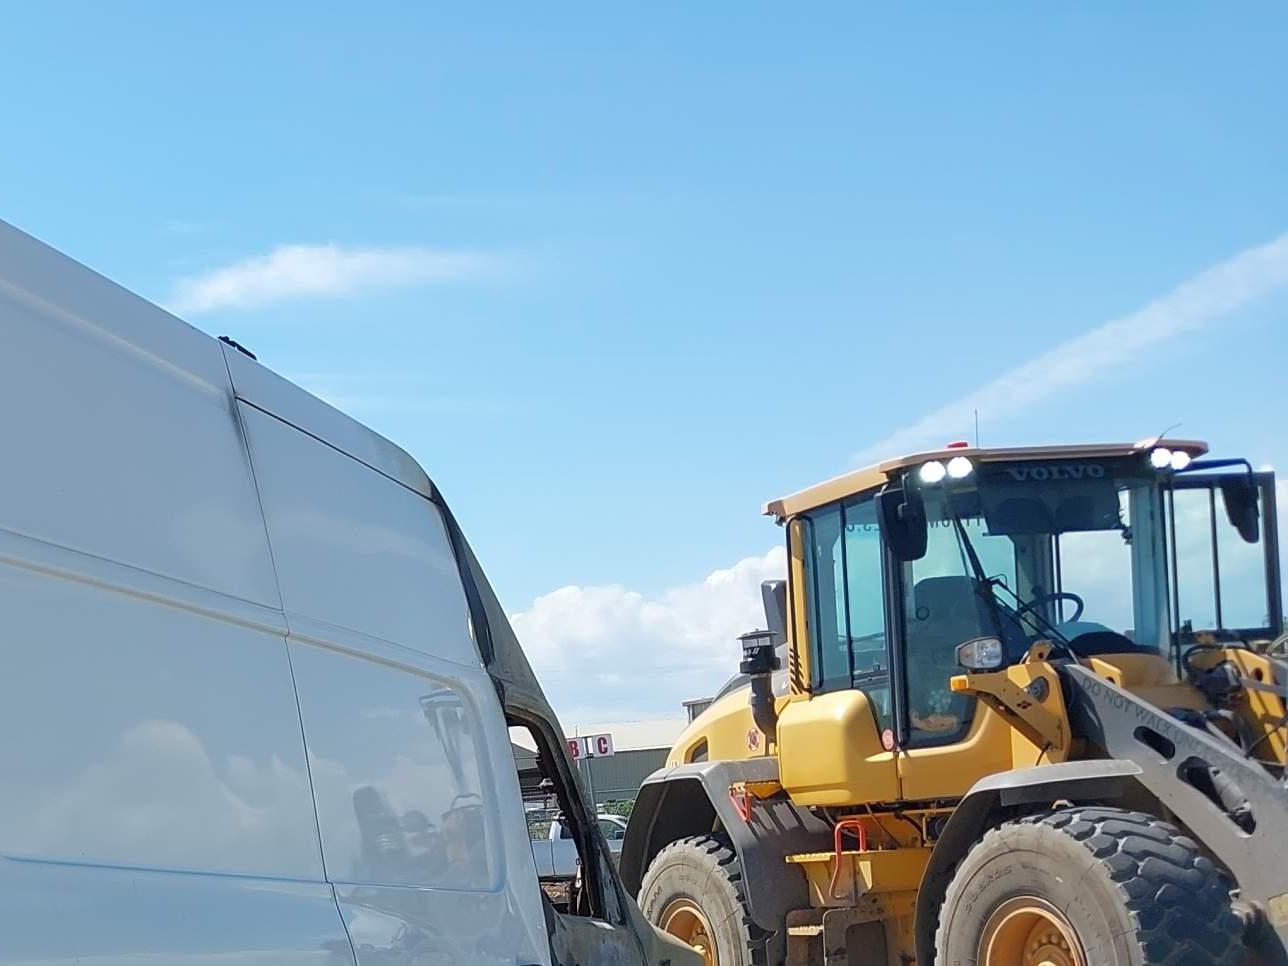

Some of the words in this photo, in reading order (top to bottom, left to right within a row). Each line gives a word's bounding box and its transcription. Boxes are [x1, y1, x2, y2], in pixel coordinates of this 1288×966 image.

[1004, 464, 1105, 480] VOLVO
[1081, 676, 1101, 697] DO
[1103, 690, 1131, 713] NOT
[568, 740, 579, 758] B
[598, 737, 608, 755] C
